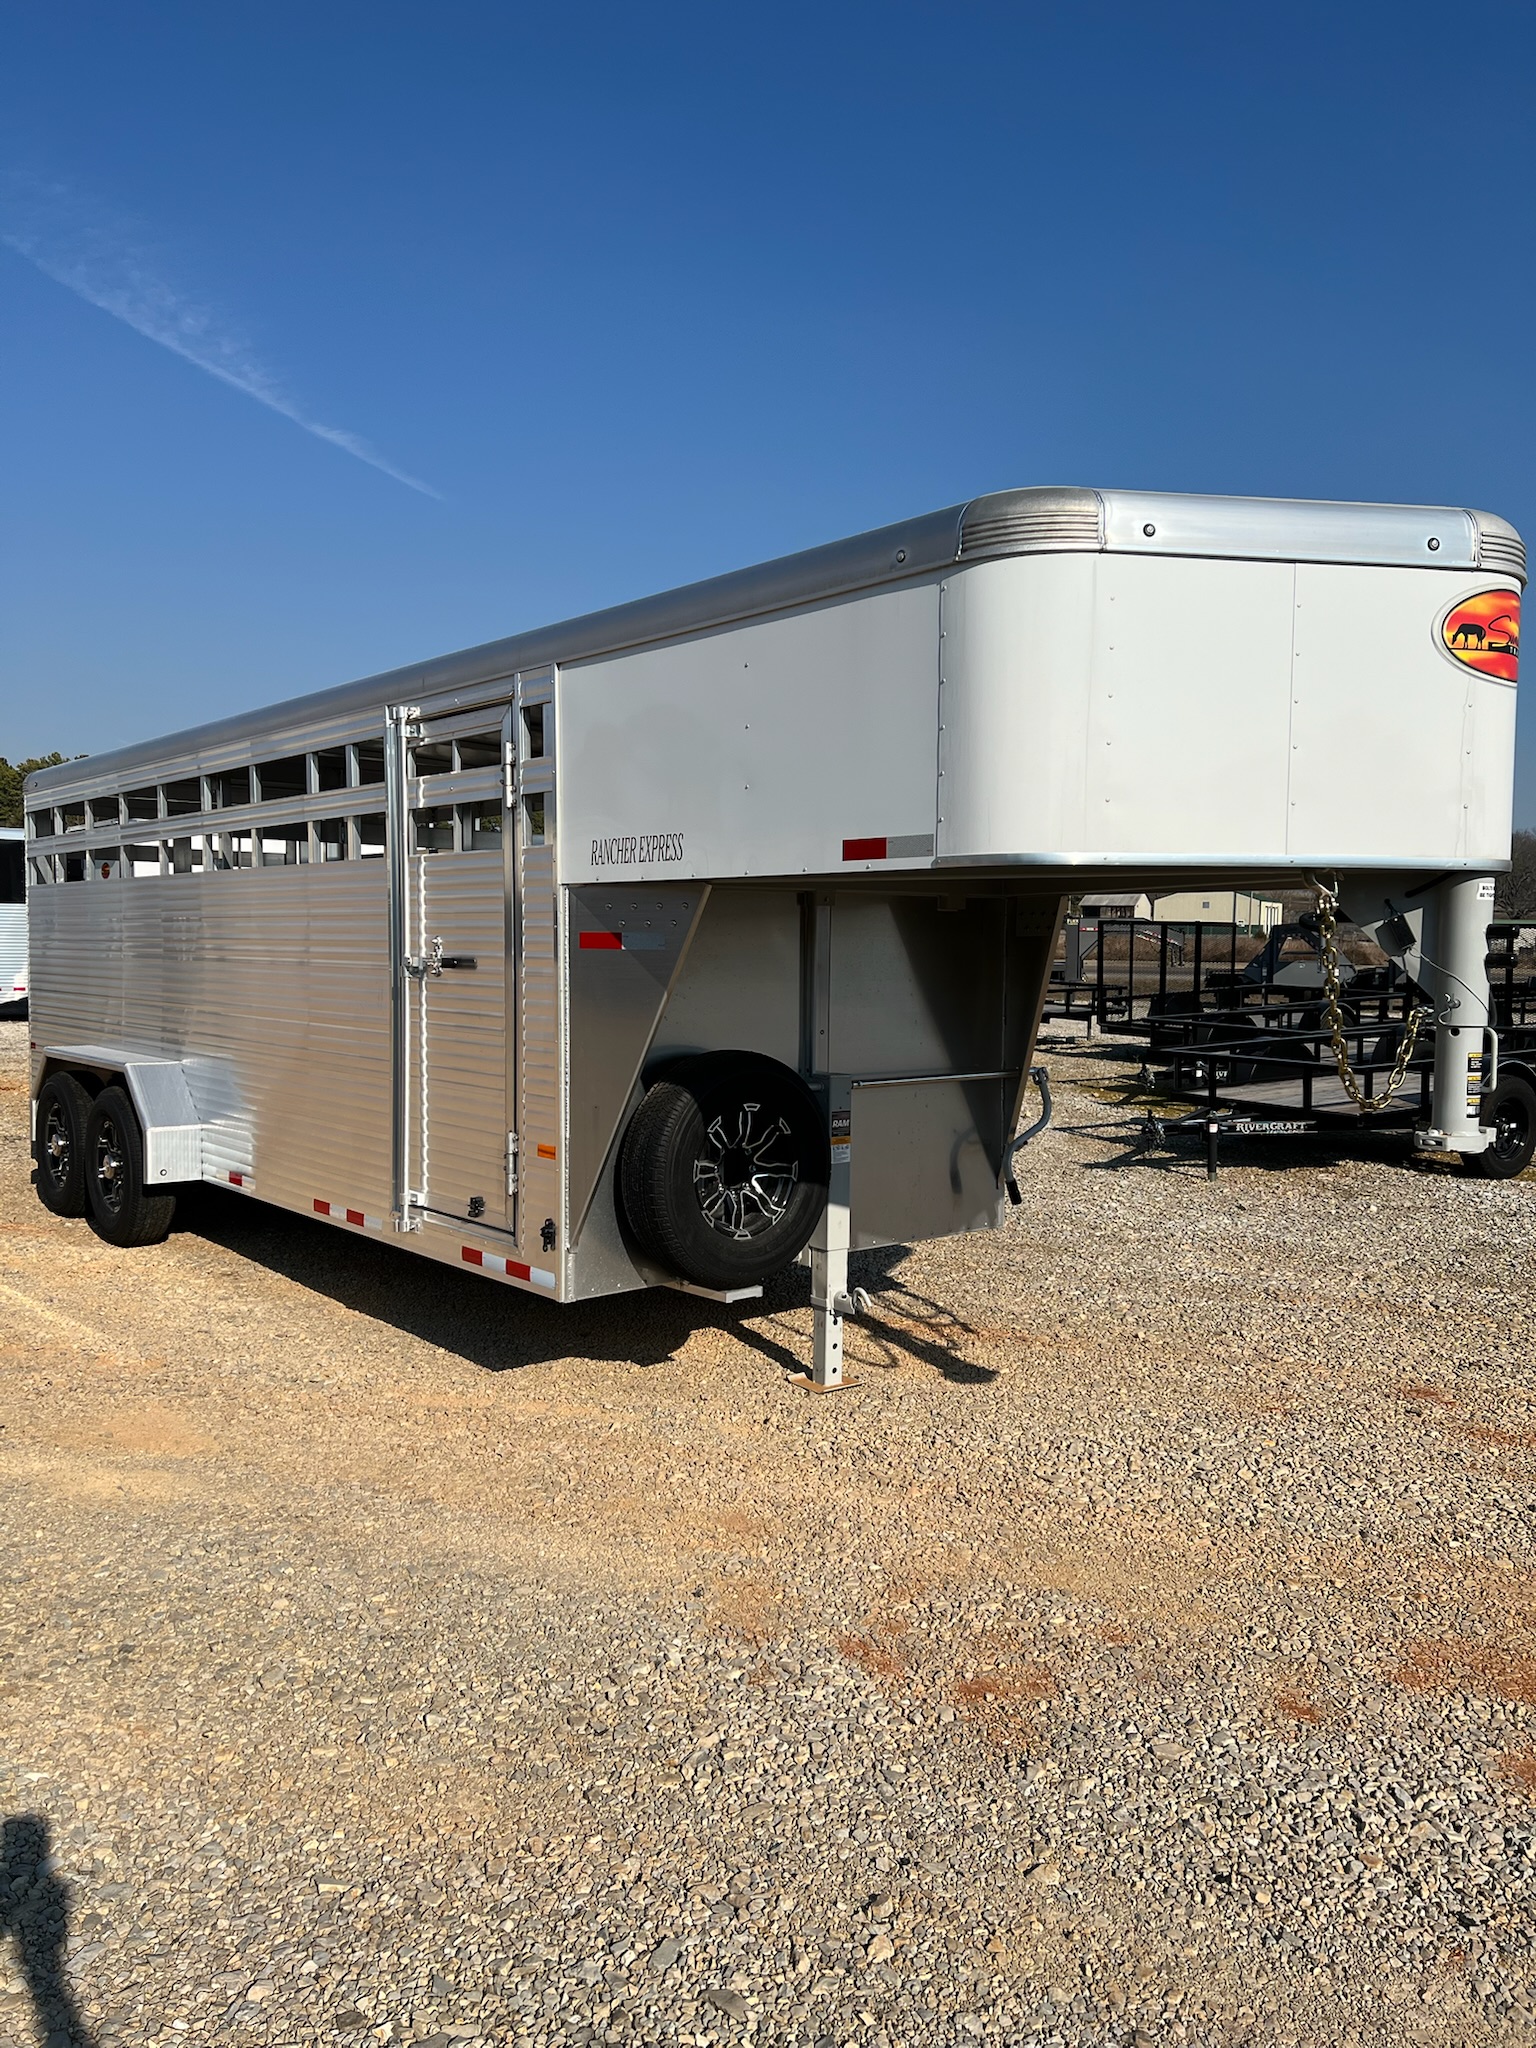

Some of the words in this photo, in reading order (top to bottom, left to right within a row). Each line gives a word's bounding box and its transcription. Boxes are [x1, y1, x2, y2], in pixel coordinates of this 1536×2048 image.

[591, 836, 637, 865] RANCHER
[639, 833, 684, 862] EXPRESS
[832, 1119, 850, 1128] RAM
